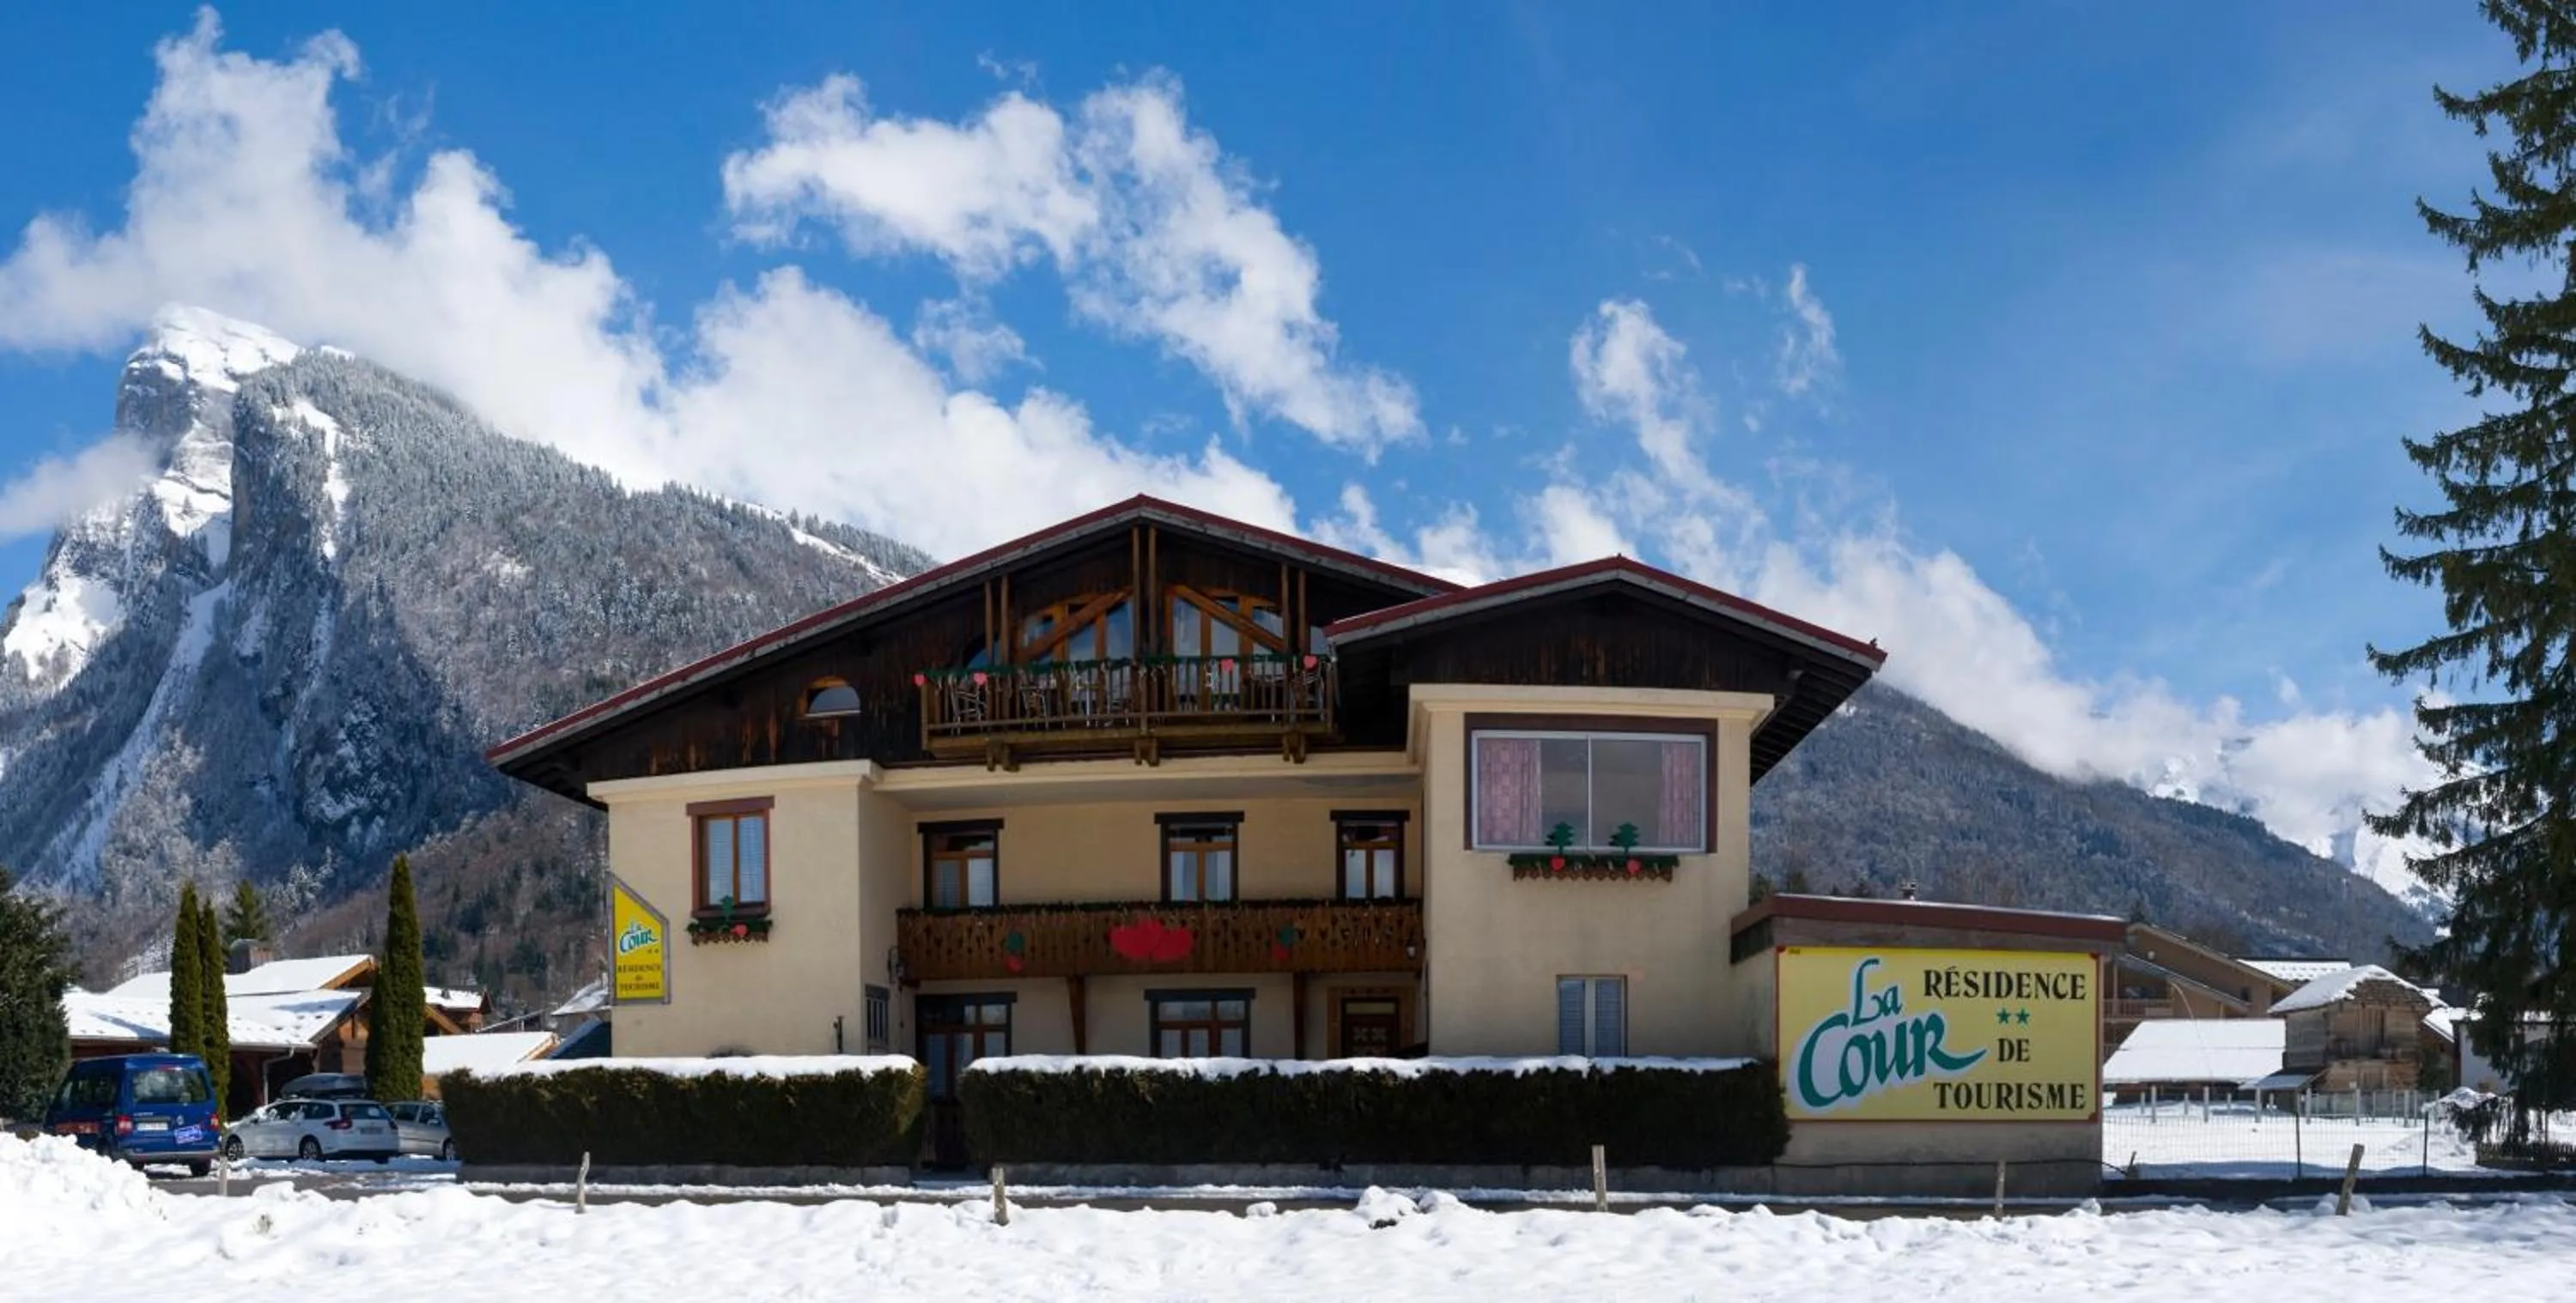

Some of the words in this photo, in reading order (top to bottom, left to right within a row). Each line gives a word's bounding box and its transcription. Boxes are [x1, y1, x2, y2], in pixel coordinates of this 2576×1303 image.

[1850, 957, 1903, 1027] La
[1923, 966, 2087, 1000] RÉSIDENCE
[1998, 1038, 2031, 1063] DE
[1934, 1082, 2086, 1112] TOURISME
